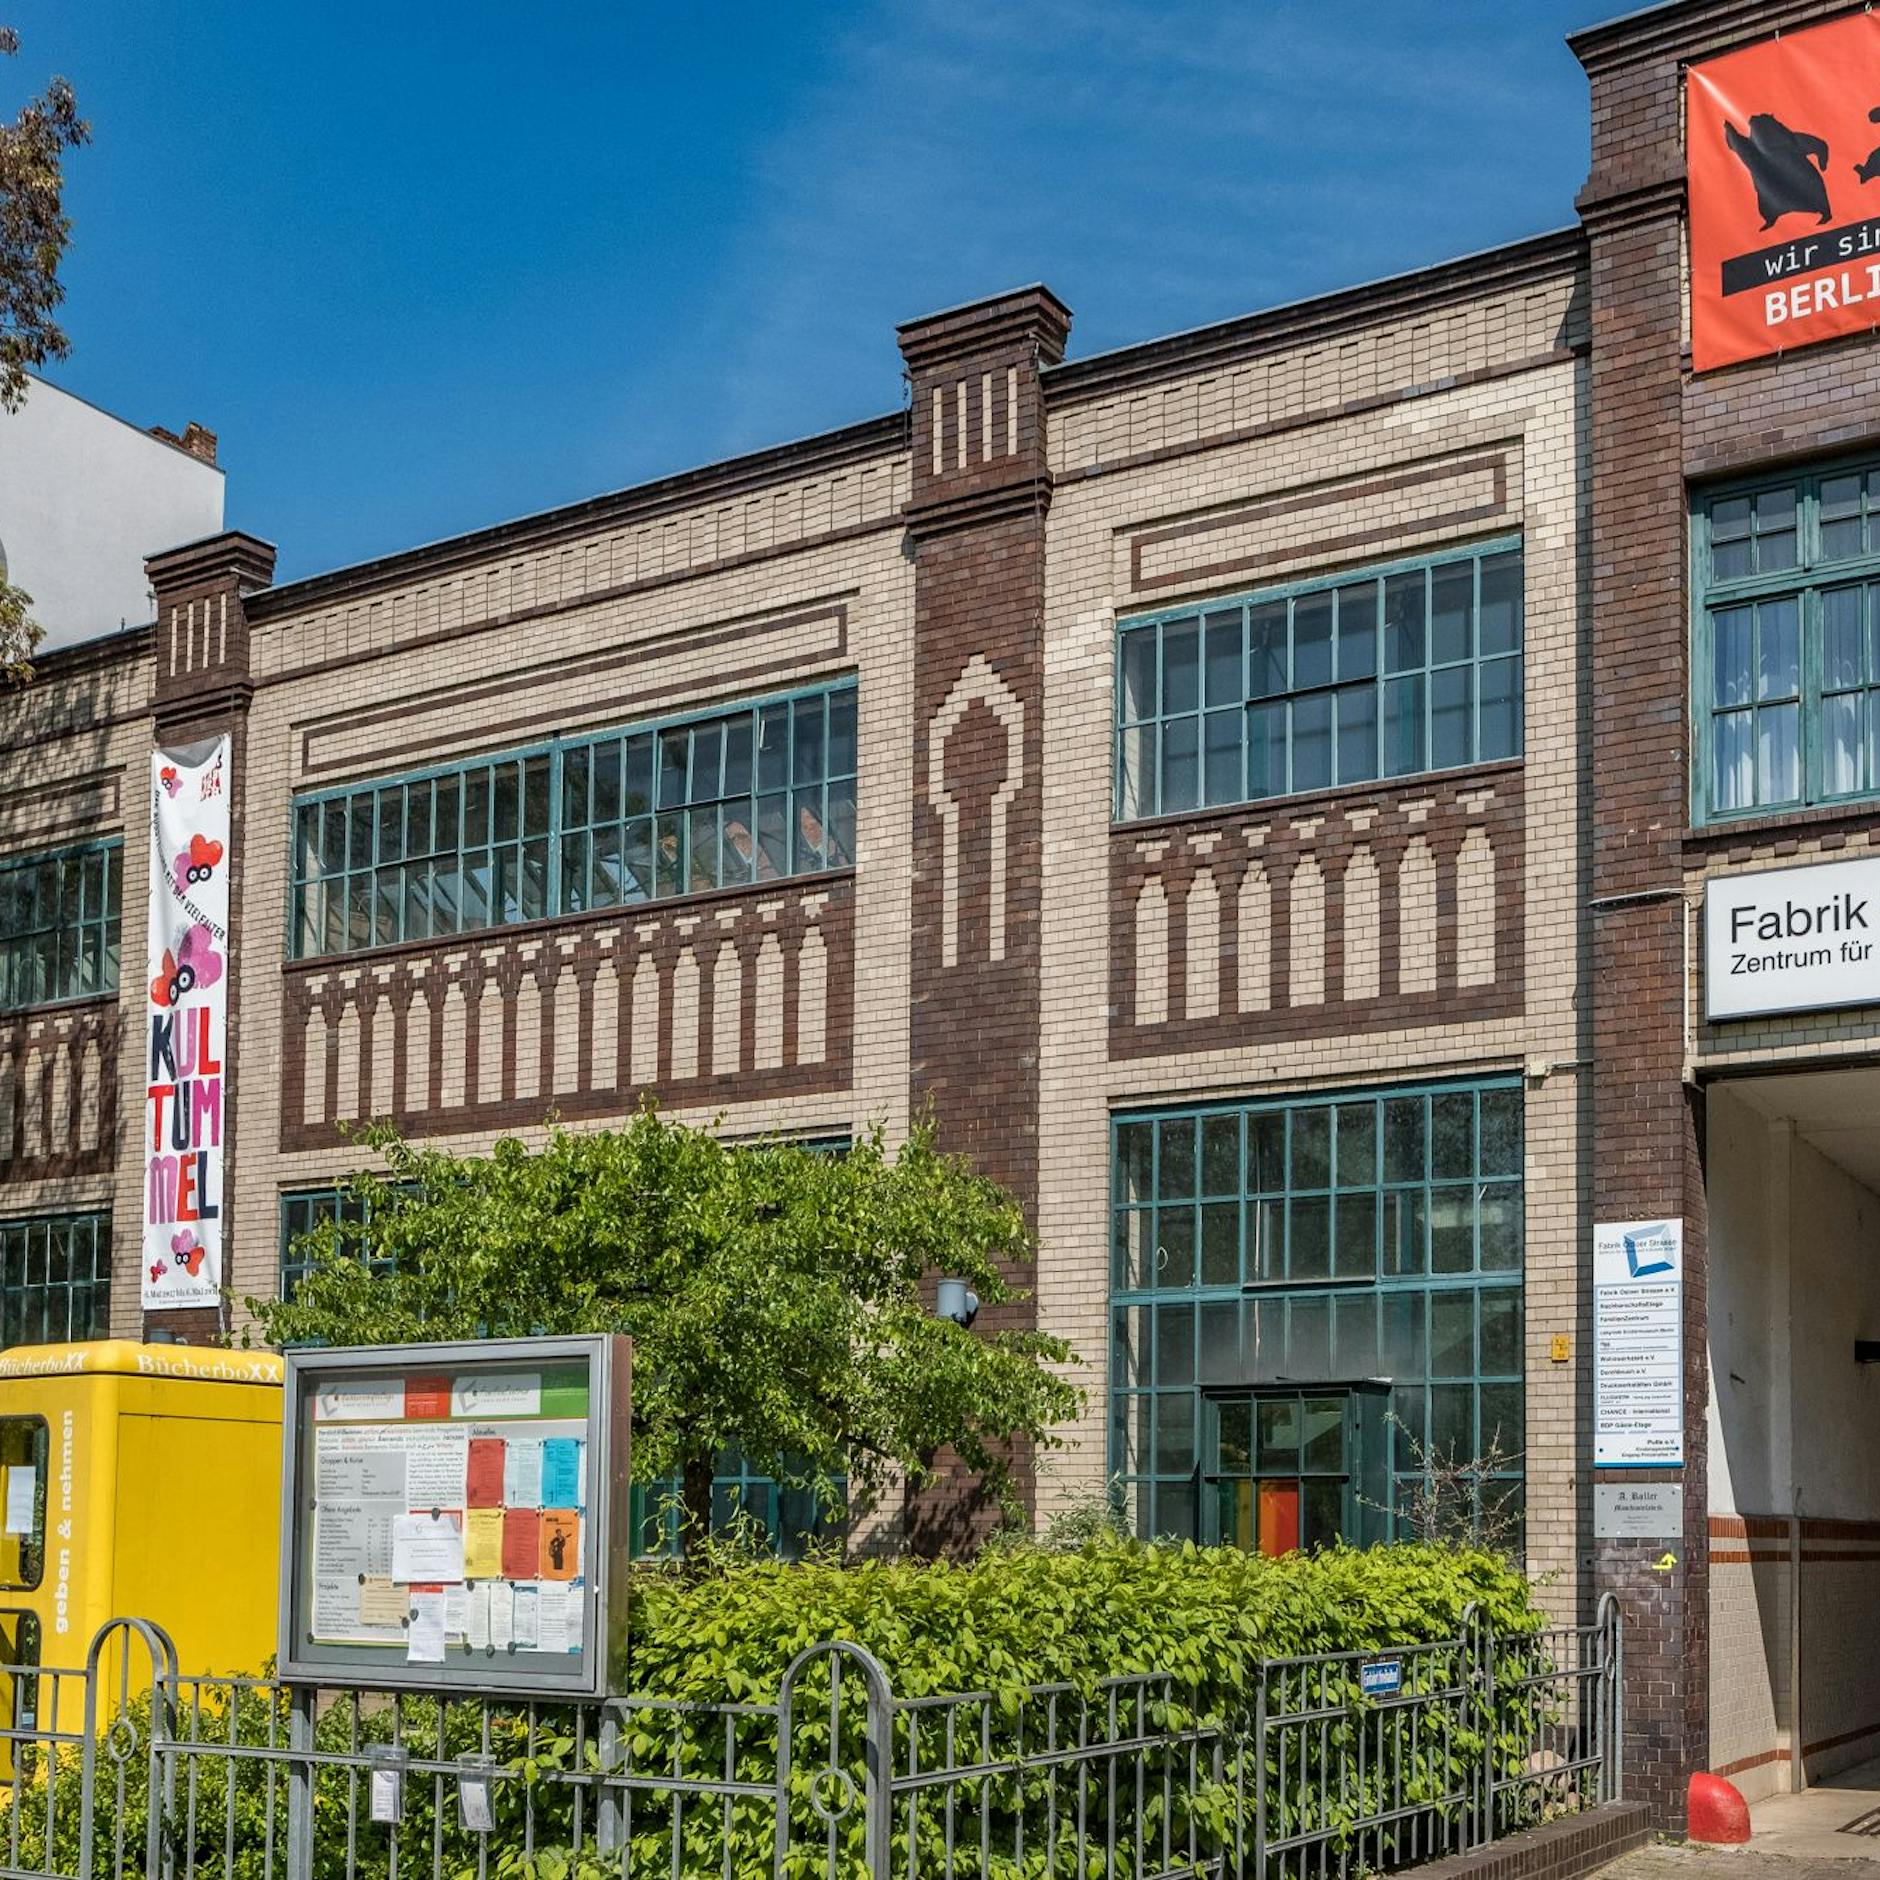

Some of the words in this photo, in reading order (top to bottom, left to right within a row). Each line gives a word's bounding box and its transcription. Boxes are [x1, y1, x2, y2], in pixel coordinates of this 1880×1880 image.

[1765, 245, 1818, 276] wir
[184, 901, 226, 940] VIELFALTER
[1731, 893, 1869, 944] Fabrik
[1730, 949, 1831, 975] Zentrum
[1840, 940, 1872, 963] für
[152, 1007, 220, 1081] KUL
[148, 1078, 220, 1152] TUM
[137, 1354, 281, 1384] BücherboXX
[59, 1410, 73, 1512] nehmen
[57, 1518, 72, 1540] &
[55, 1548, 70, 1635] geben
